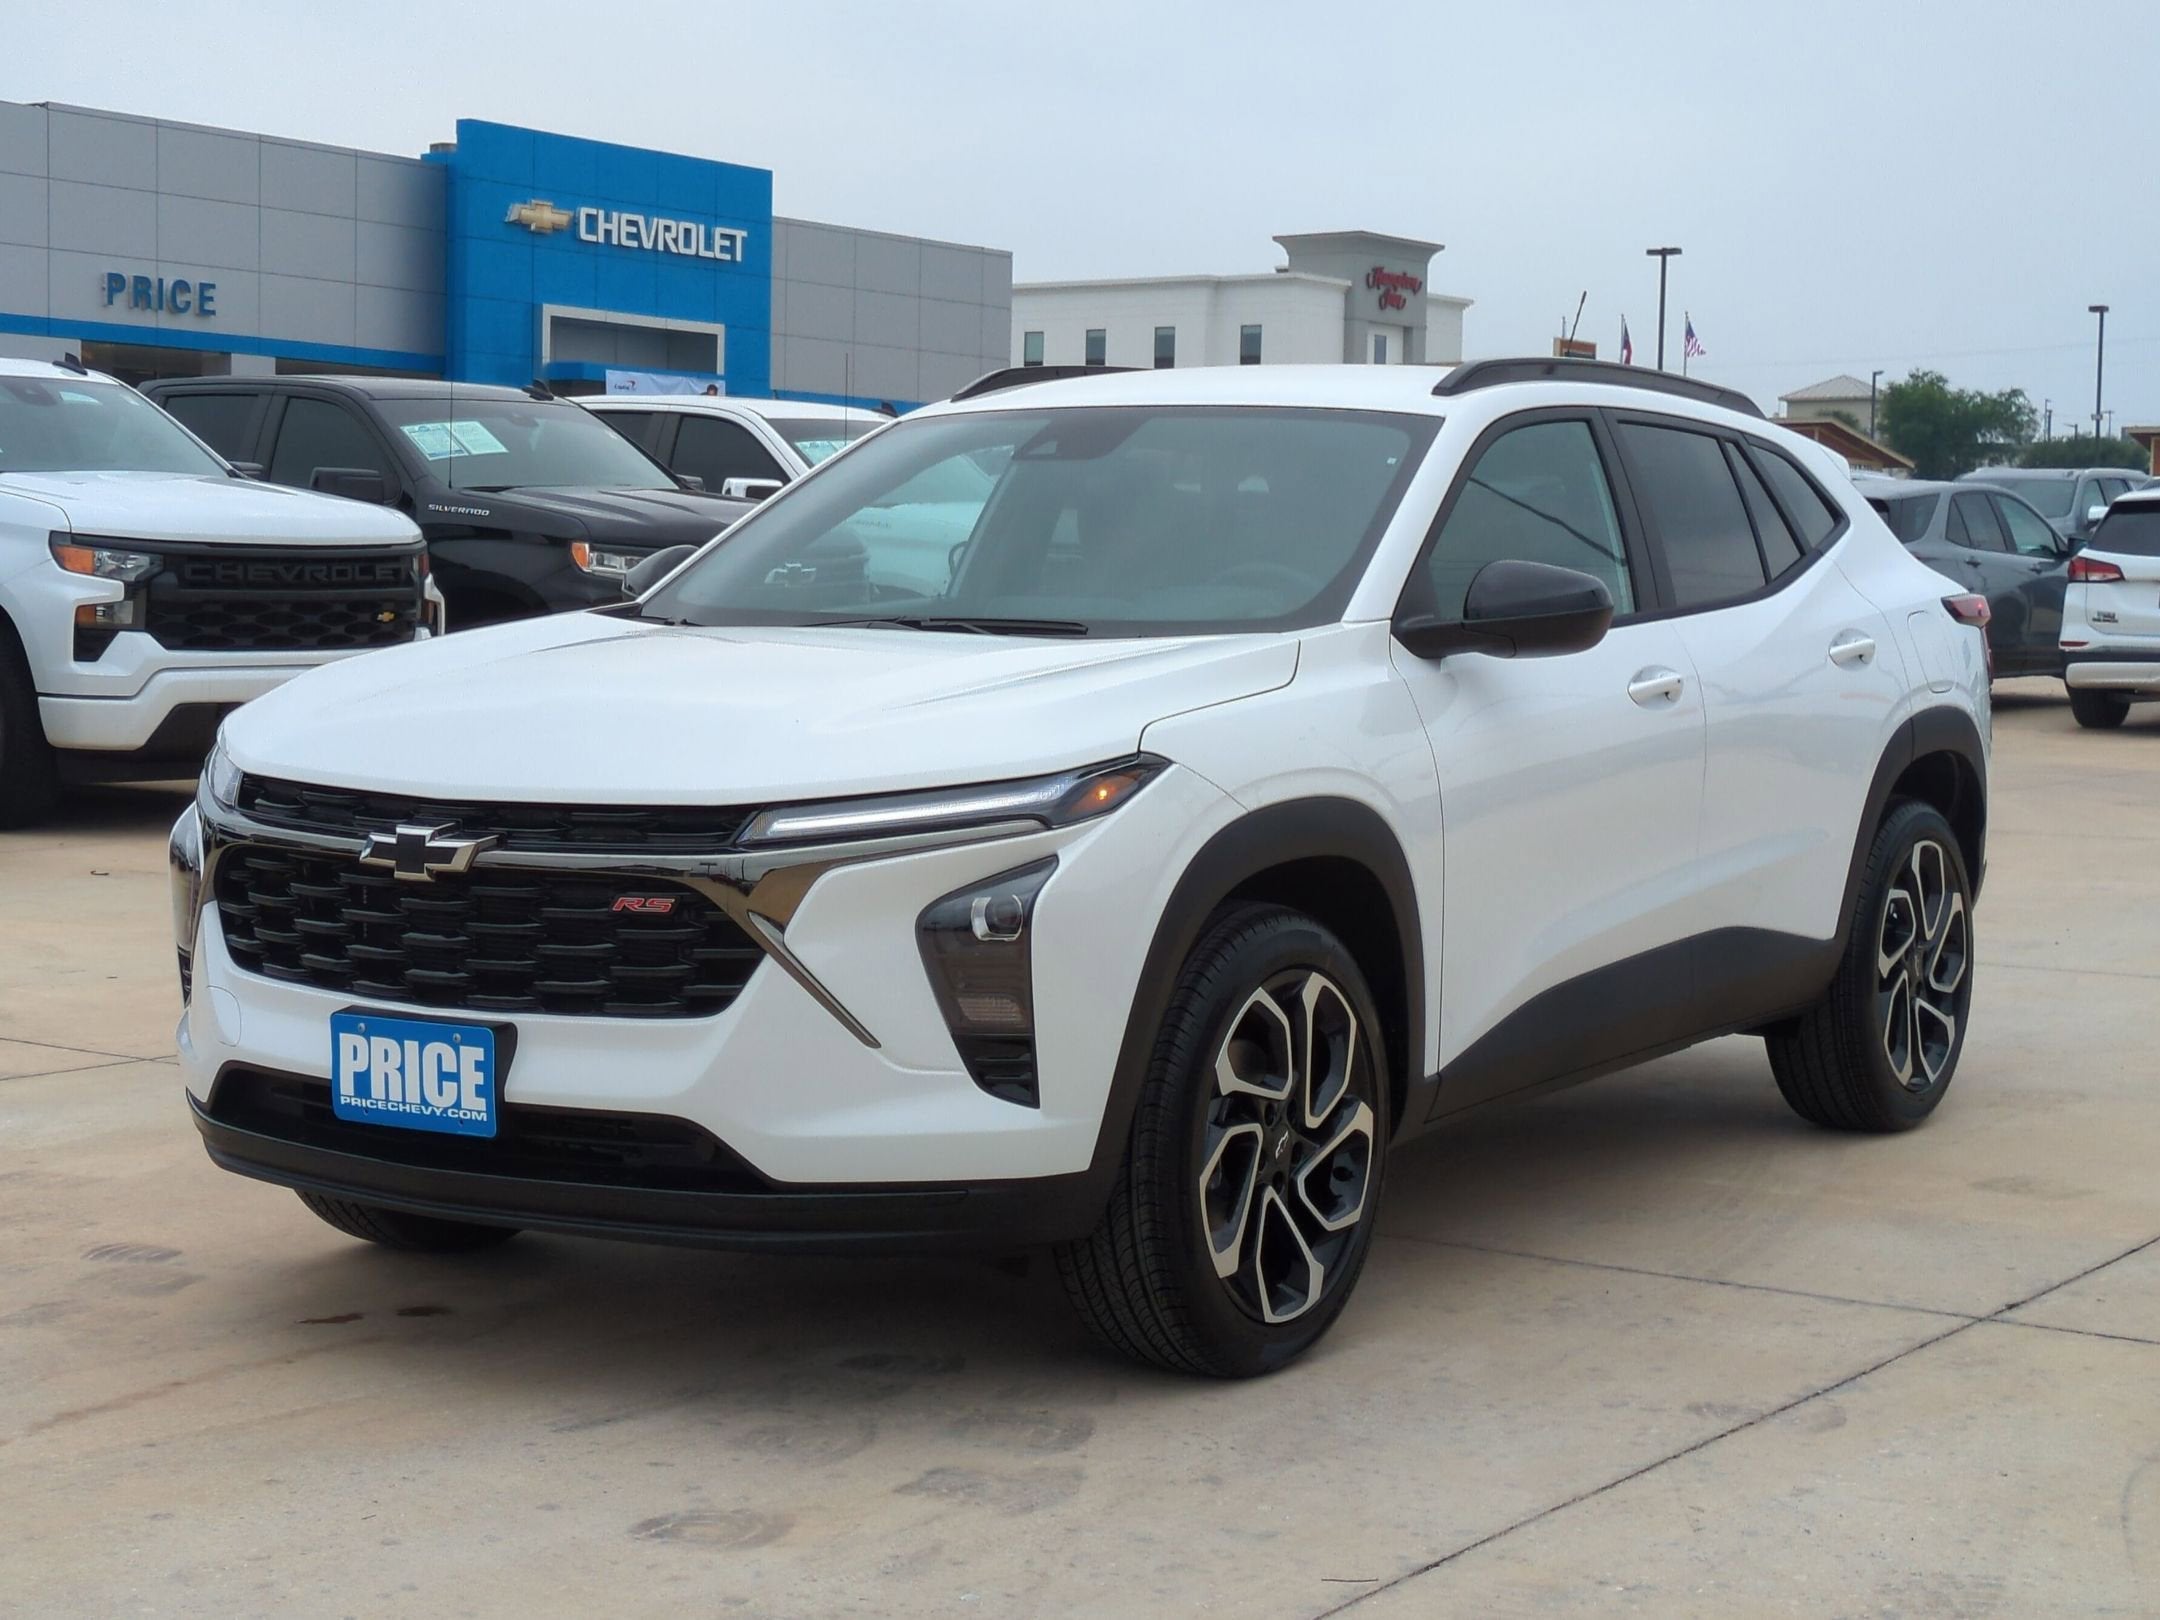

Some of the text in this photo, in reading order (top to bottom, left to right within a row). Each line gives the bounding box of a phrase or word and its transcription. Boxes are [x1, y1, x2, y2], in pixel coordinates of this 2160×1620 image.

[578, 206, 748, 262] CHEVROLET
[105, 271, 217, 317] PRICE
[427, 503, 490, 517] SILVERADO
[612, 896, 676, 913] RS
[338, 1032, 487, 1111] PRICE
[340, 1096, 488, 1122] PRICECHEVY.COM
